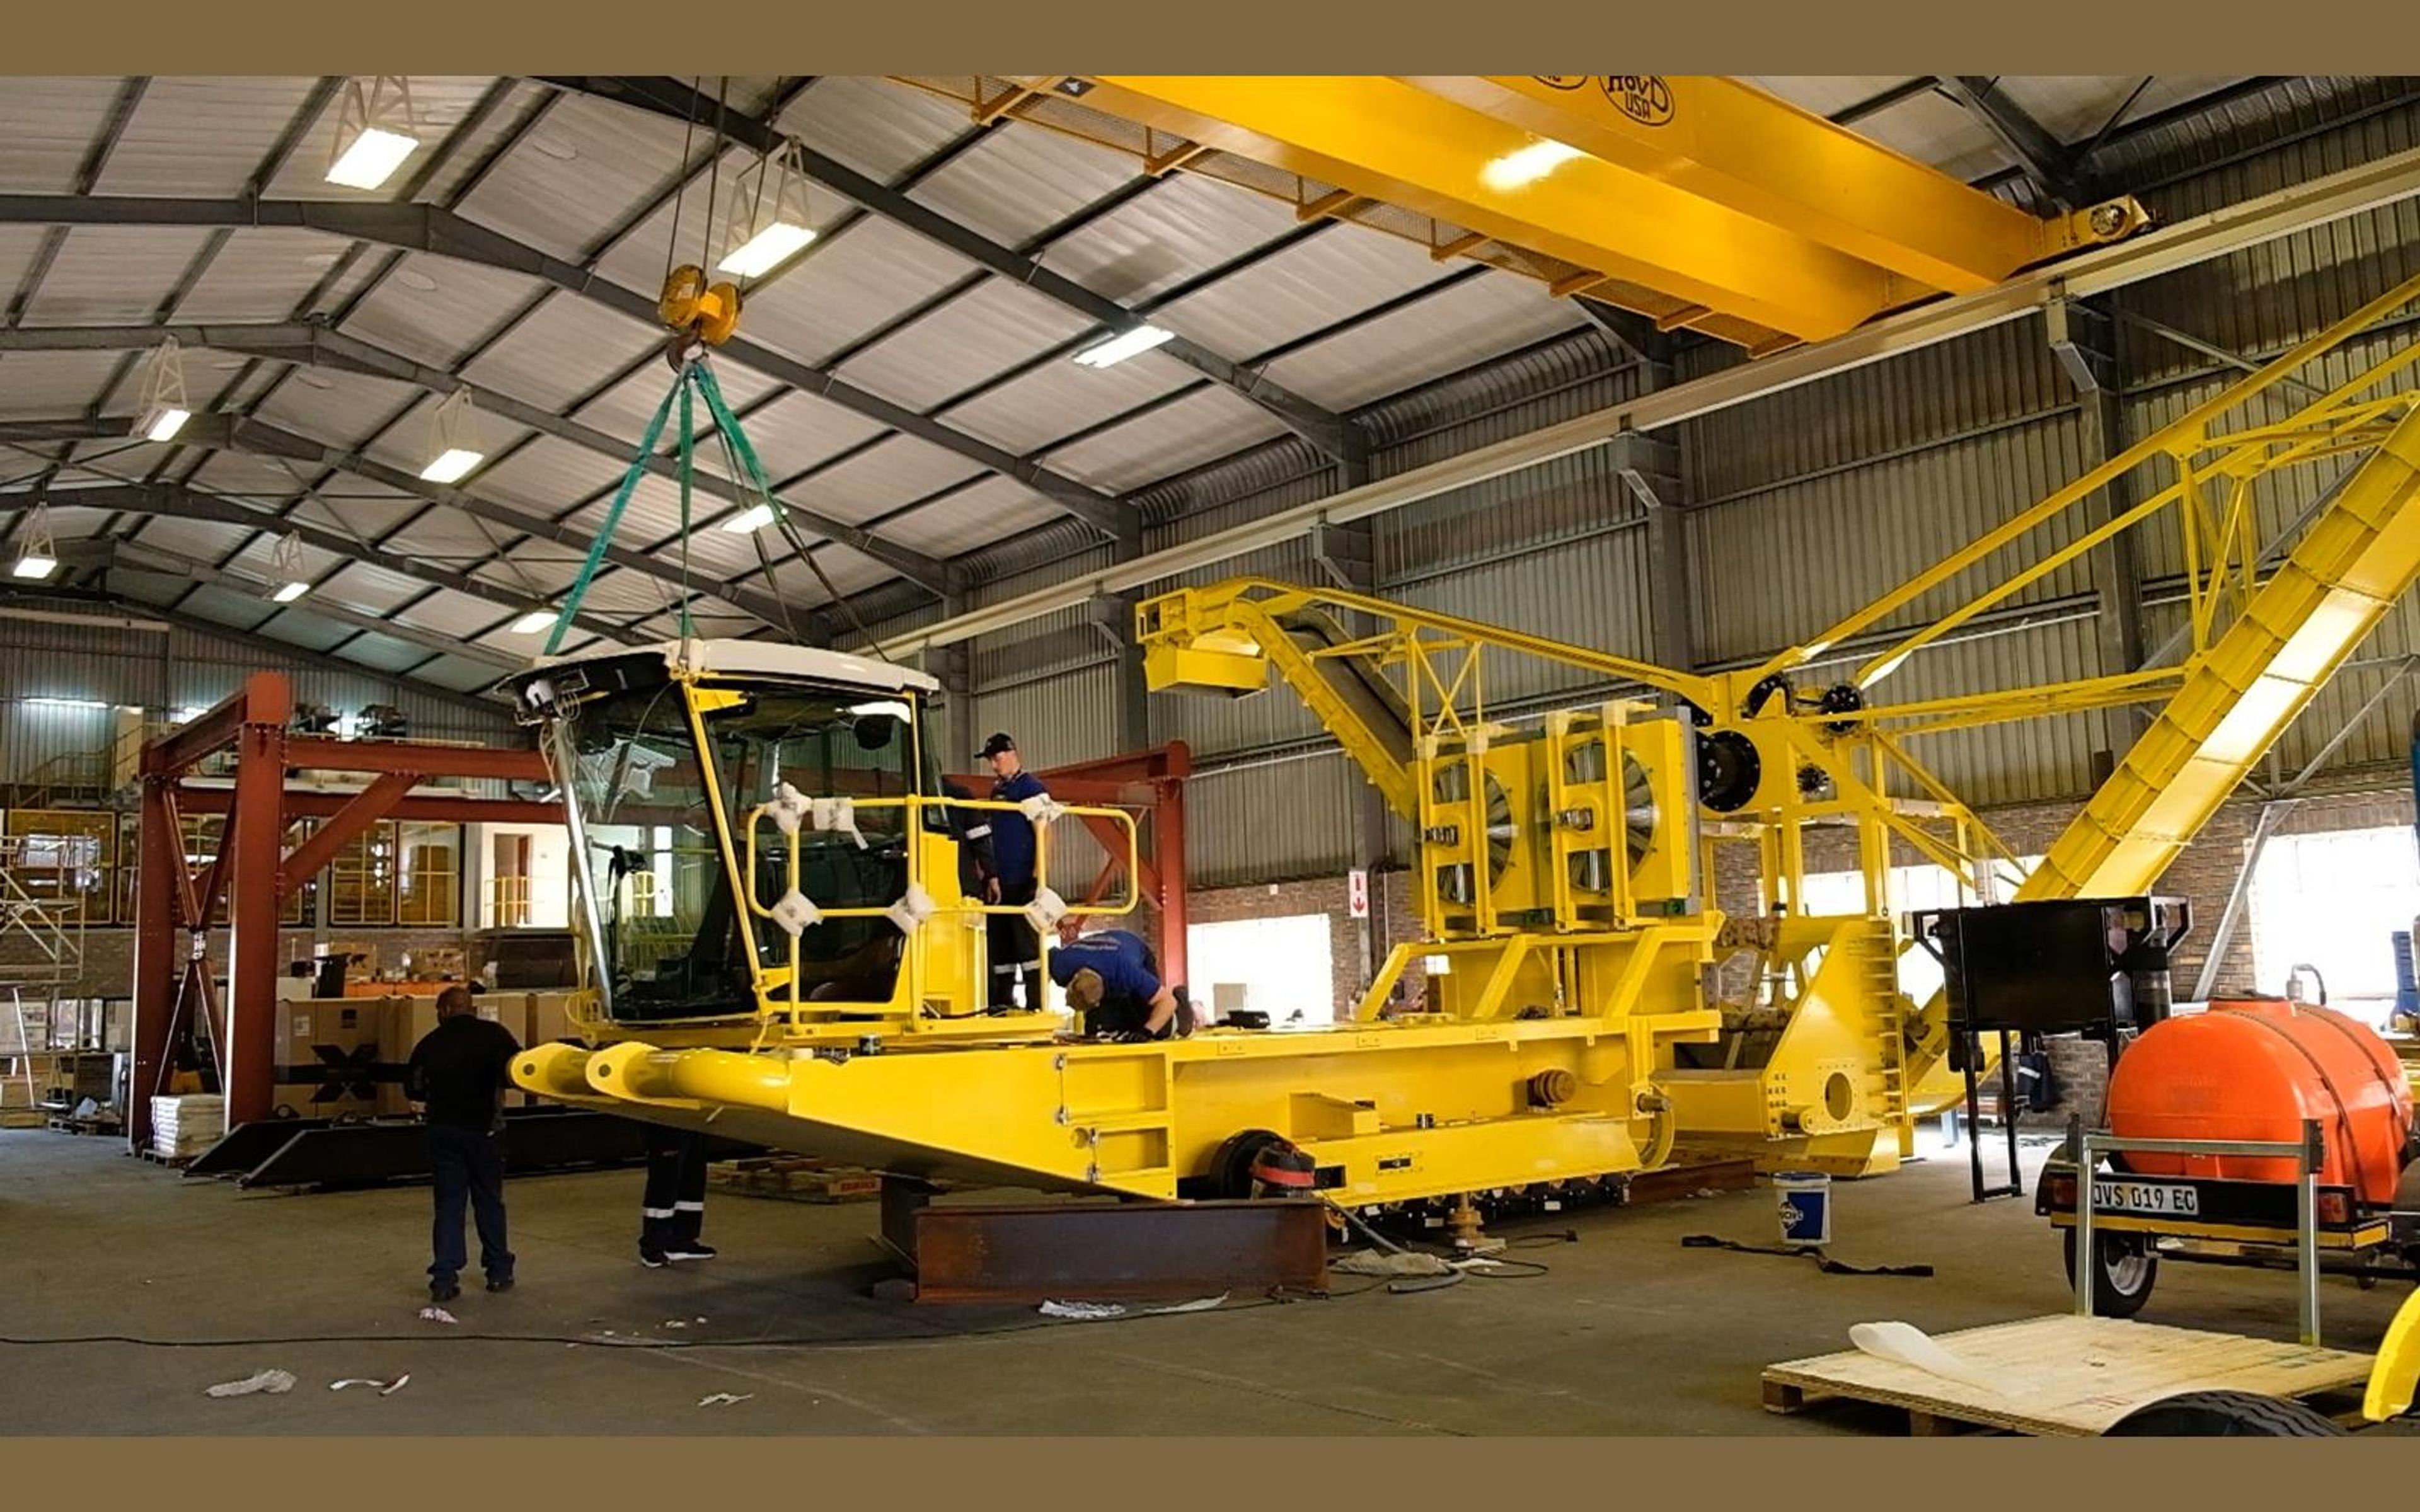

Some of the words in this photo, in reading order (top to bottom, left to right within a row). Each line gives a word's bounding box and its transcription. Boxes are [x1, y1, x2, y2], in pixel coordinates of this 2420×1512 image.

[1625, 91, 1651, 119] USA
[2131, 1187, 2164, 1210] 019
[2172, 1188, 2196, 1211] EC
